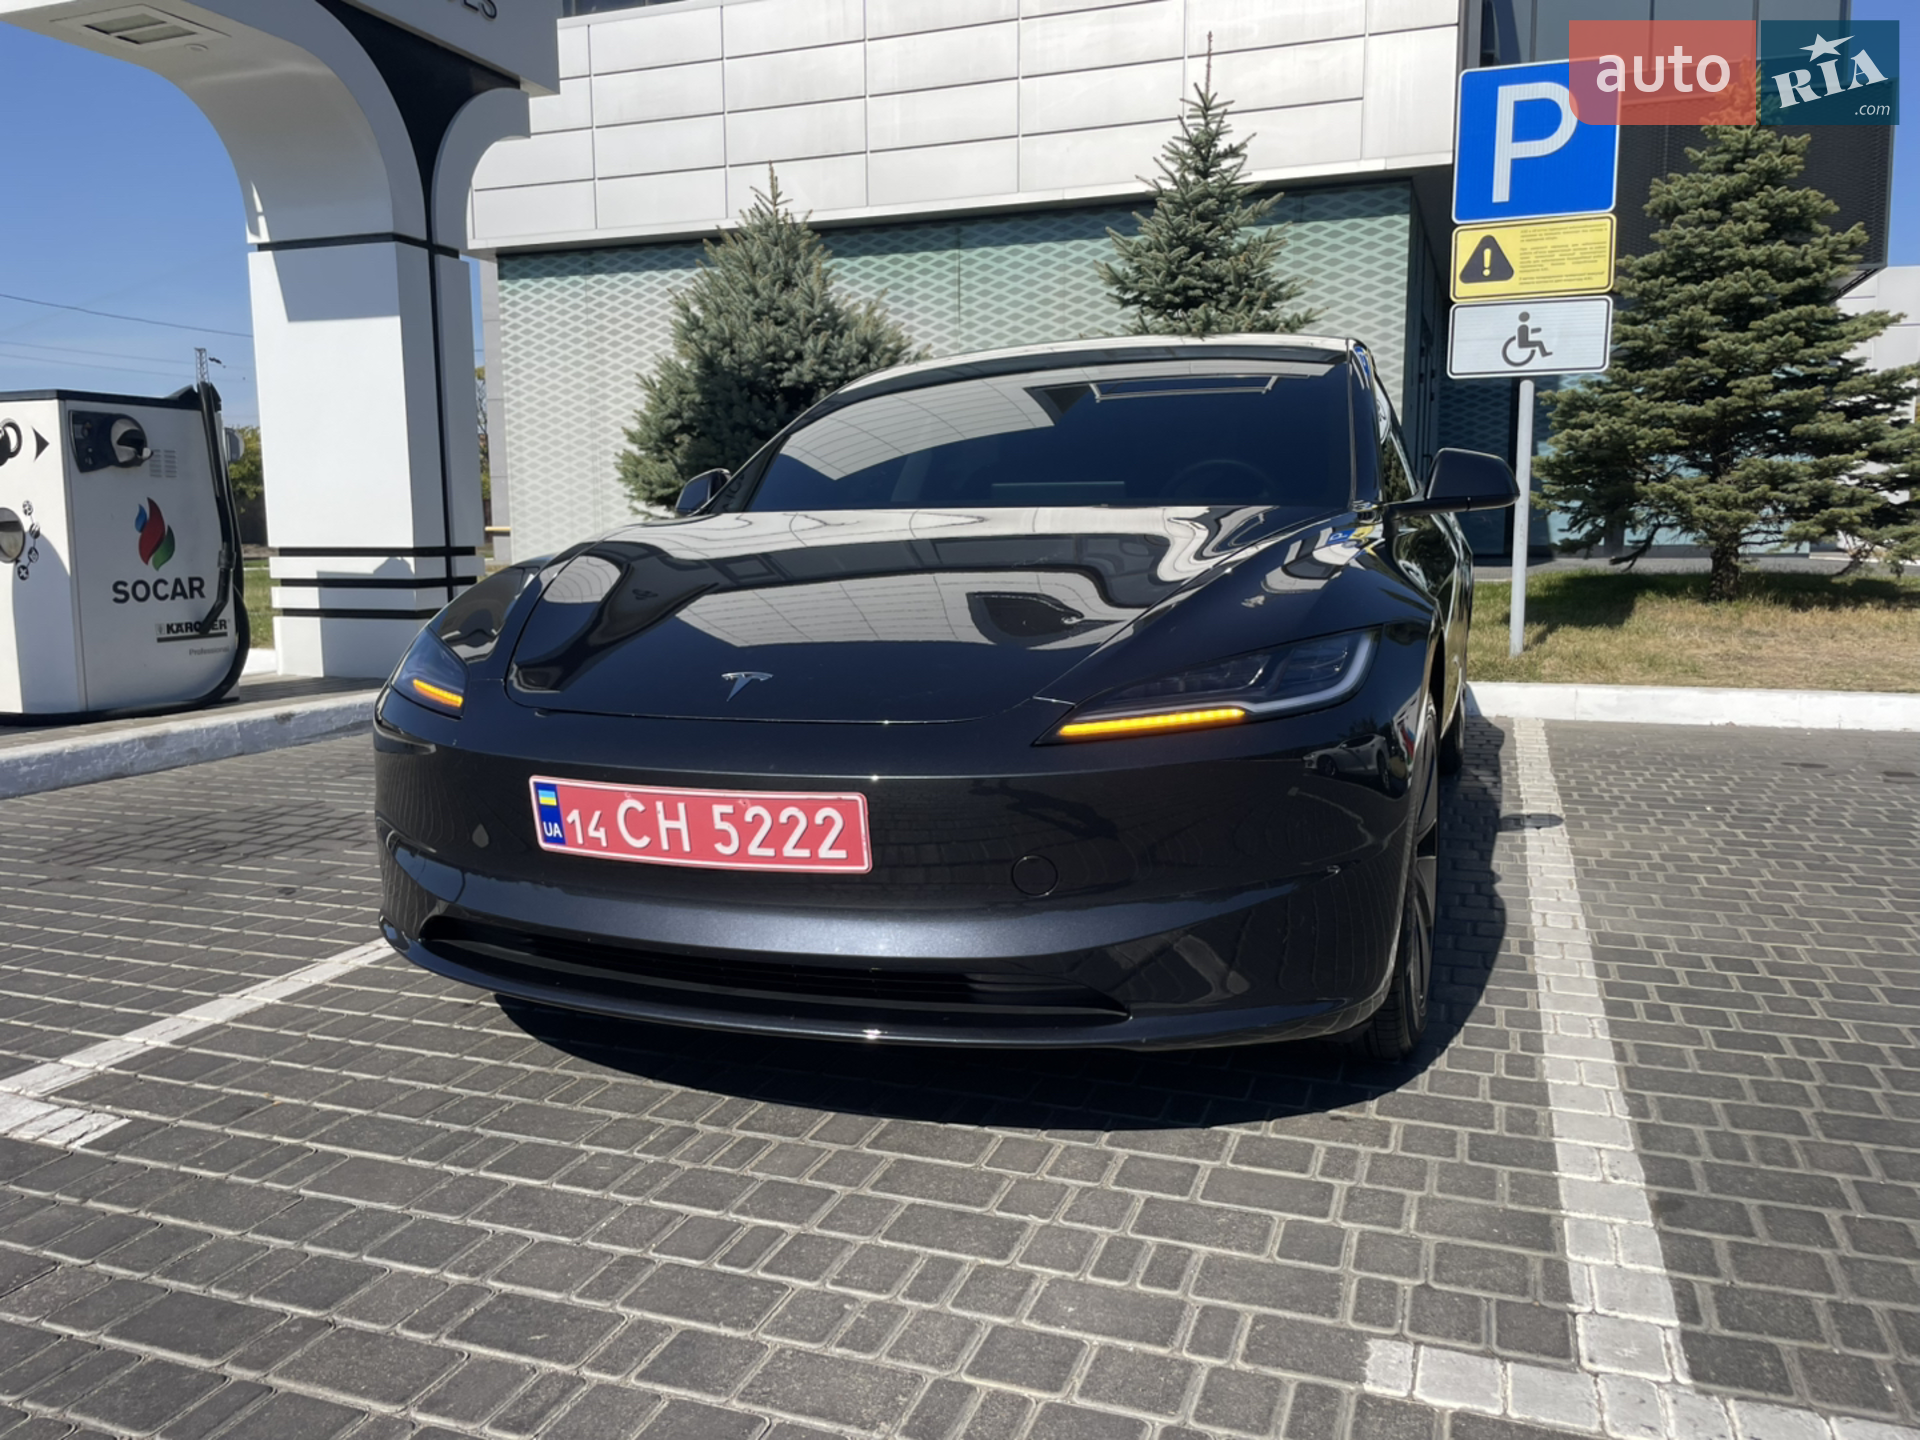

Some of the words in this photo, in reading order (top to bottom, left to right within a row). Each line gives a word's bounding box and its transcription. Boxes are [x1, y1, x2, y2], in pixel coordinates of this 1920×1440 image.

[1492, 81, 1579, 203] P
[112, 576, 206, 604] SOCAR
[166, 619, 228, 635] KÄRCER
[543, 821, 563, 838] UA
[566, 809, 608, 848] 14
[616, 798, 692, 852] CH
[712, 804, 848, 860] 5222
